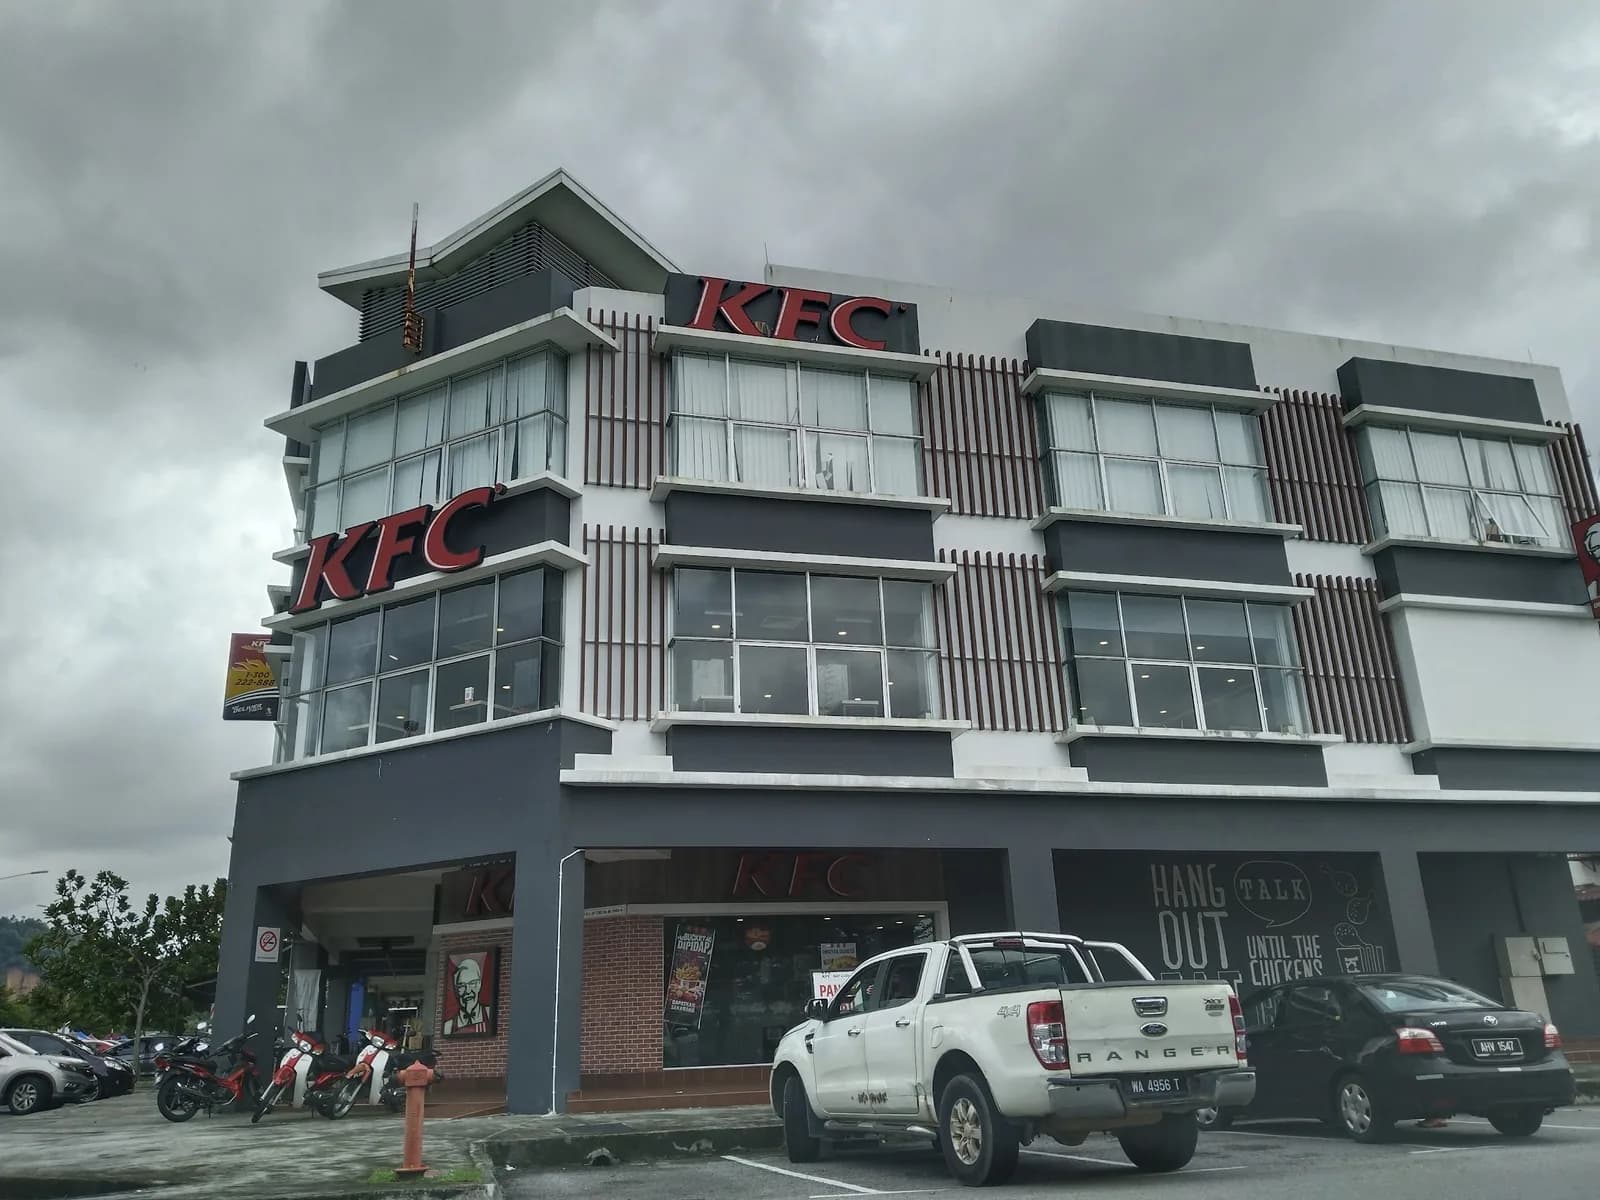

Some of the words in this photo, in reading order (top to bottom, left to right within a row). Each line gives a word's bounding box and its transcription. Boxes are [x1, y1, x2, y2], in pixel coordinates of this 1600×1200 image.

[688, 276, 892, 350] KFC
[288, 486, 495, 615] KFC
[730, 853, 869, 896] KFC
[1150, 863, 1226, 909] HANG
[1239, 878, 1307, 901] TALK
[1158, 910, 1229, 969] OUT
[1246, 935, 1291, 959] UNTIL
[1291, 934, 1322, 959] THE
[1249, 958, 1323, 986] CHICKENS
[1077, 1045, 1231, 1063] RANGER
[1497, 1040, 1515, 1052] 1547
[1131, 1079, 1145, 1093] WA
[1147, 1079, 1171, 1092] 4956
[1174, 1078, 1180, 1091] T
